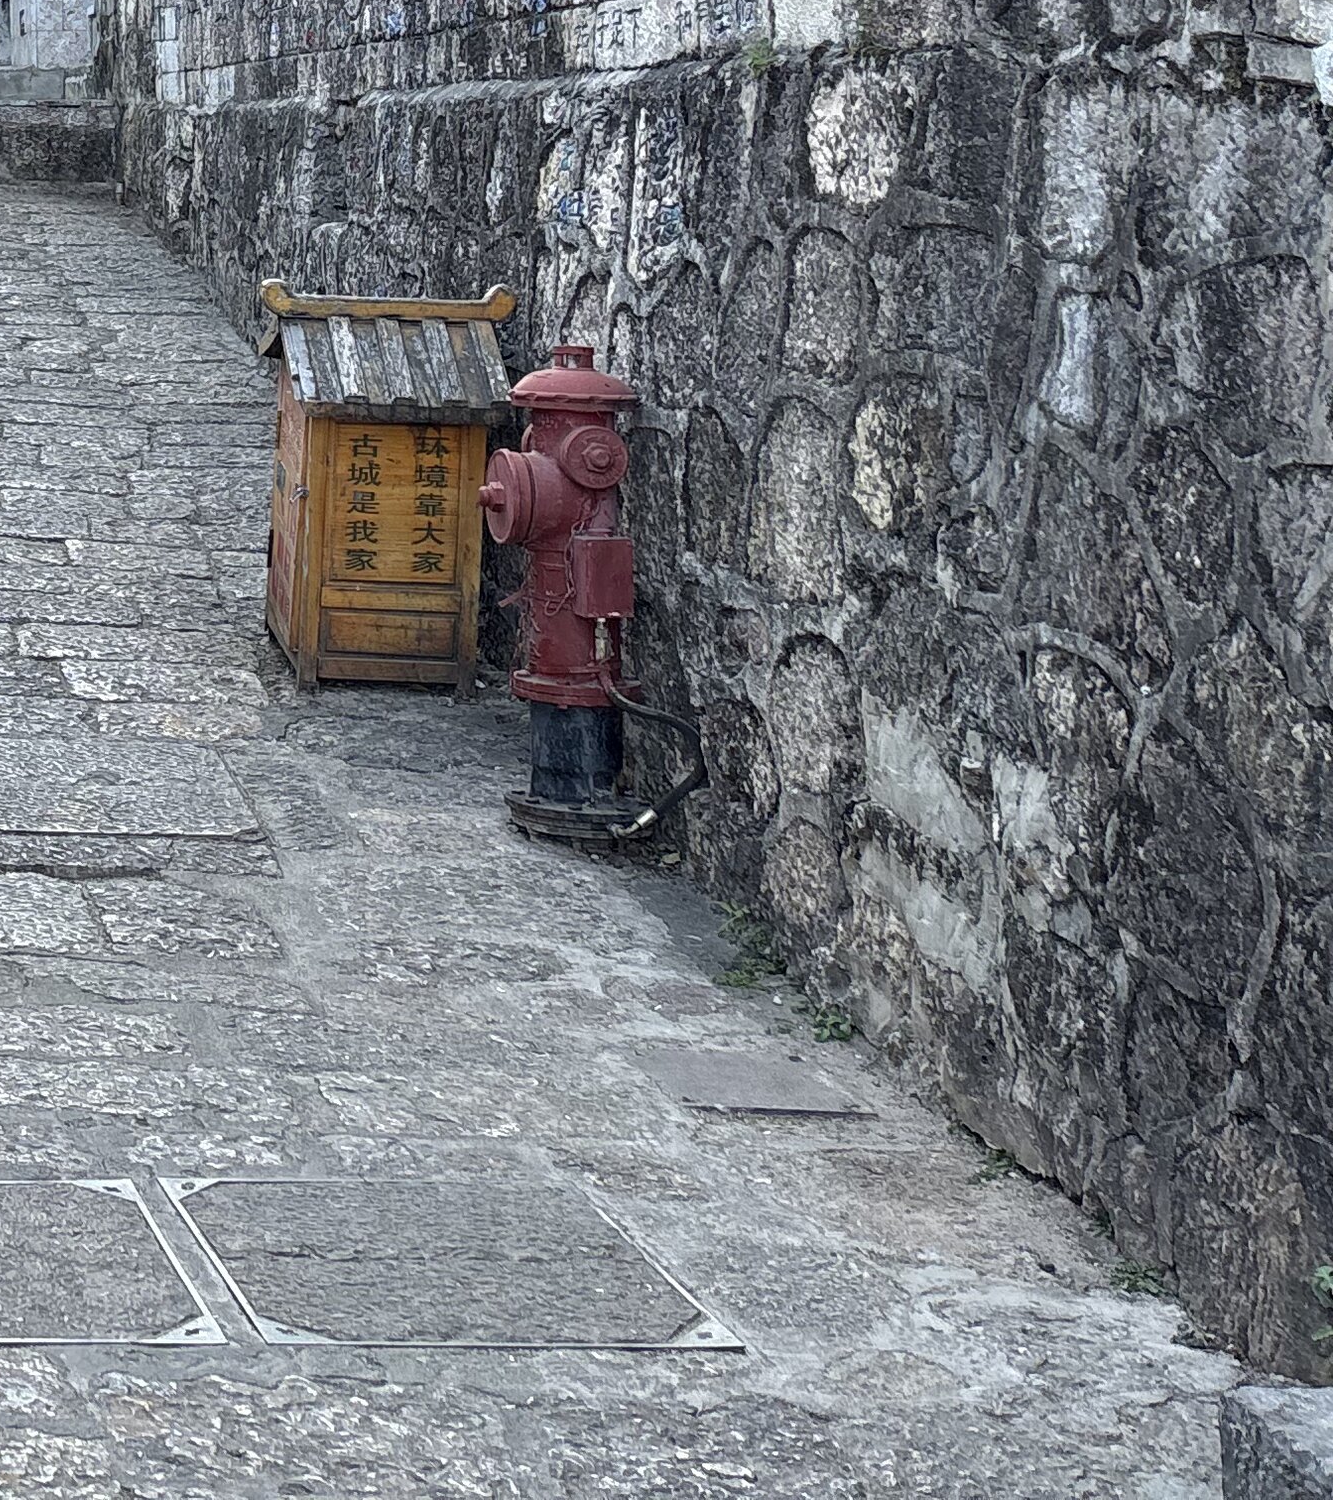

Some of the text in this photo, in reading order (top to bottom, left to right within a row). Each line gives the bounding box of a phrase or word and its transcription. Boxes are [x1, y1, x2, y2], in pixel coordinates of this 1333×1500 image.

[345, 434, 382, 572] 古城是我家
[410, 434, 450, 574] 环境靠大家
